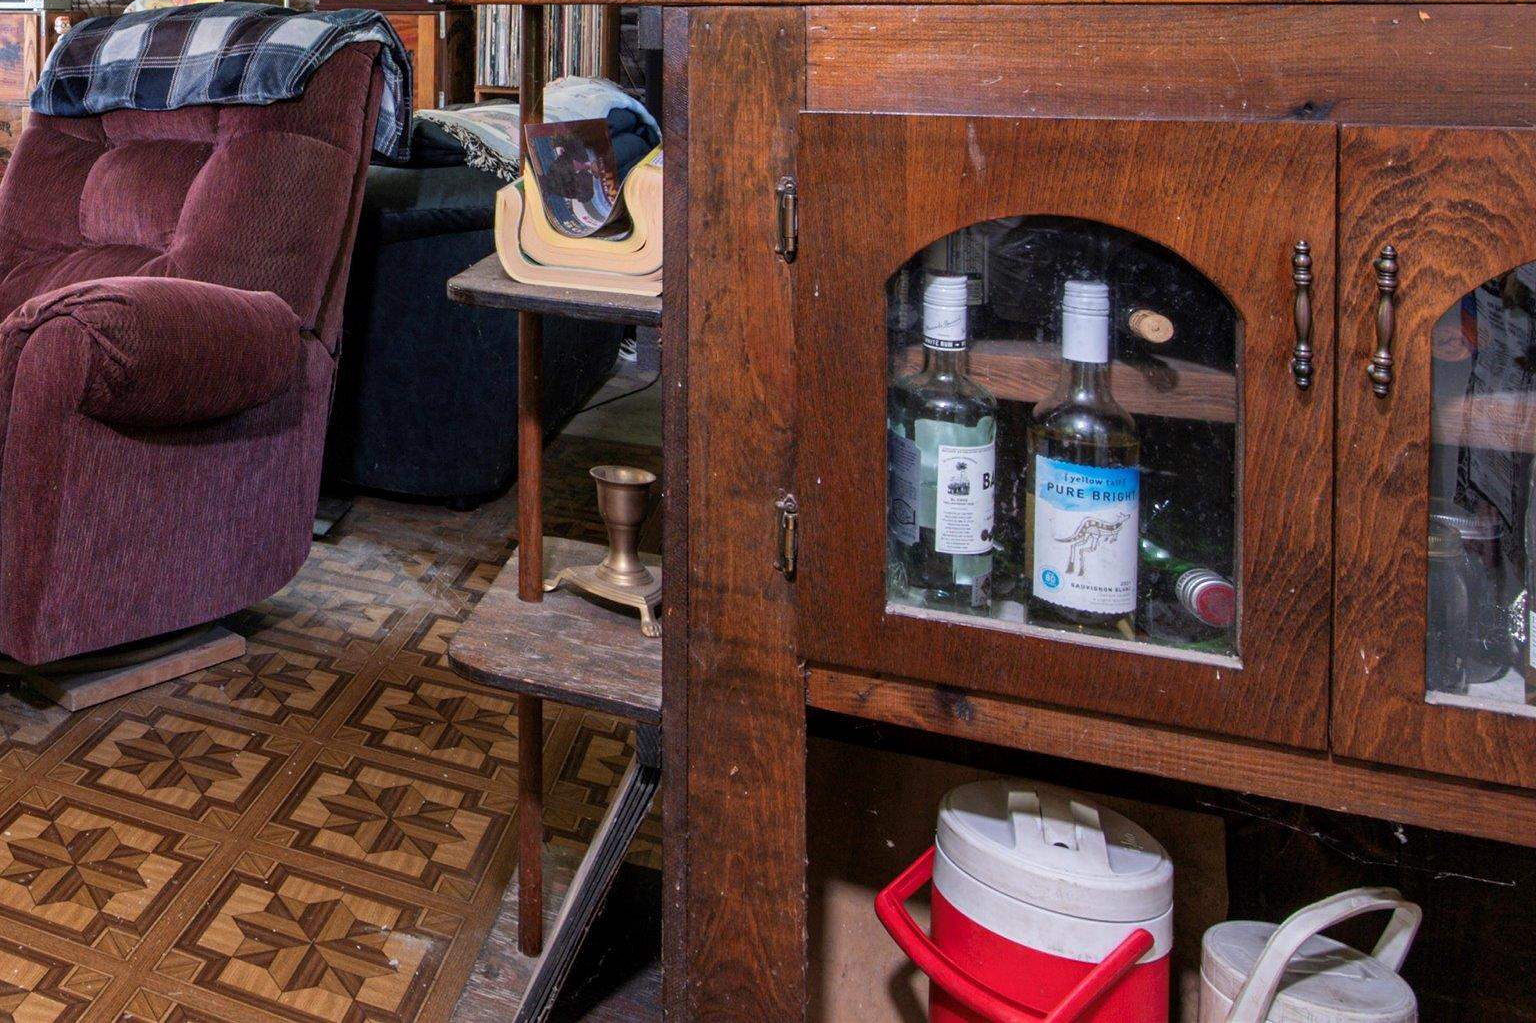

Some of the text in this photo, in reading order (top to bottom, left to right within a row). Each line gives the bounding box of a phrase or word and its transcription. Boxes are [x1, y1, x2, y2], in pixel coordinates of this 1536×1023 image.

[1047, 481, 1136, 502] PURE BRIGHT
[1070, 582, 1113, 592] SAUVIGNON
